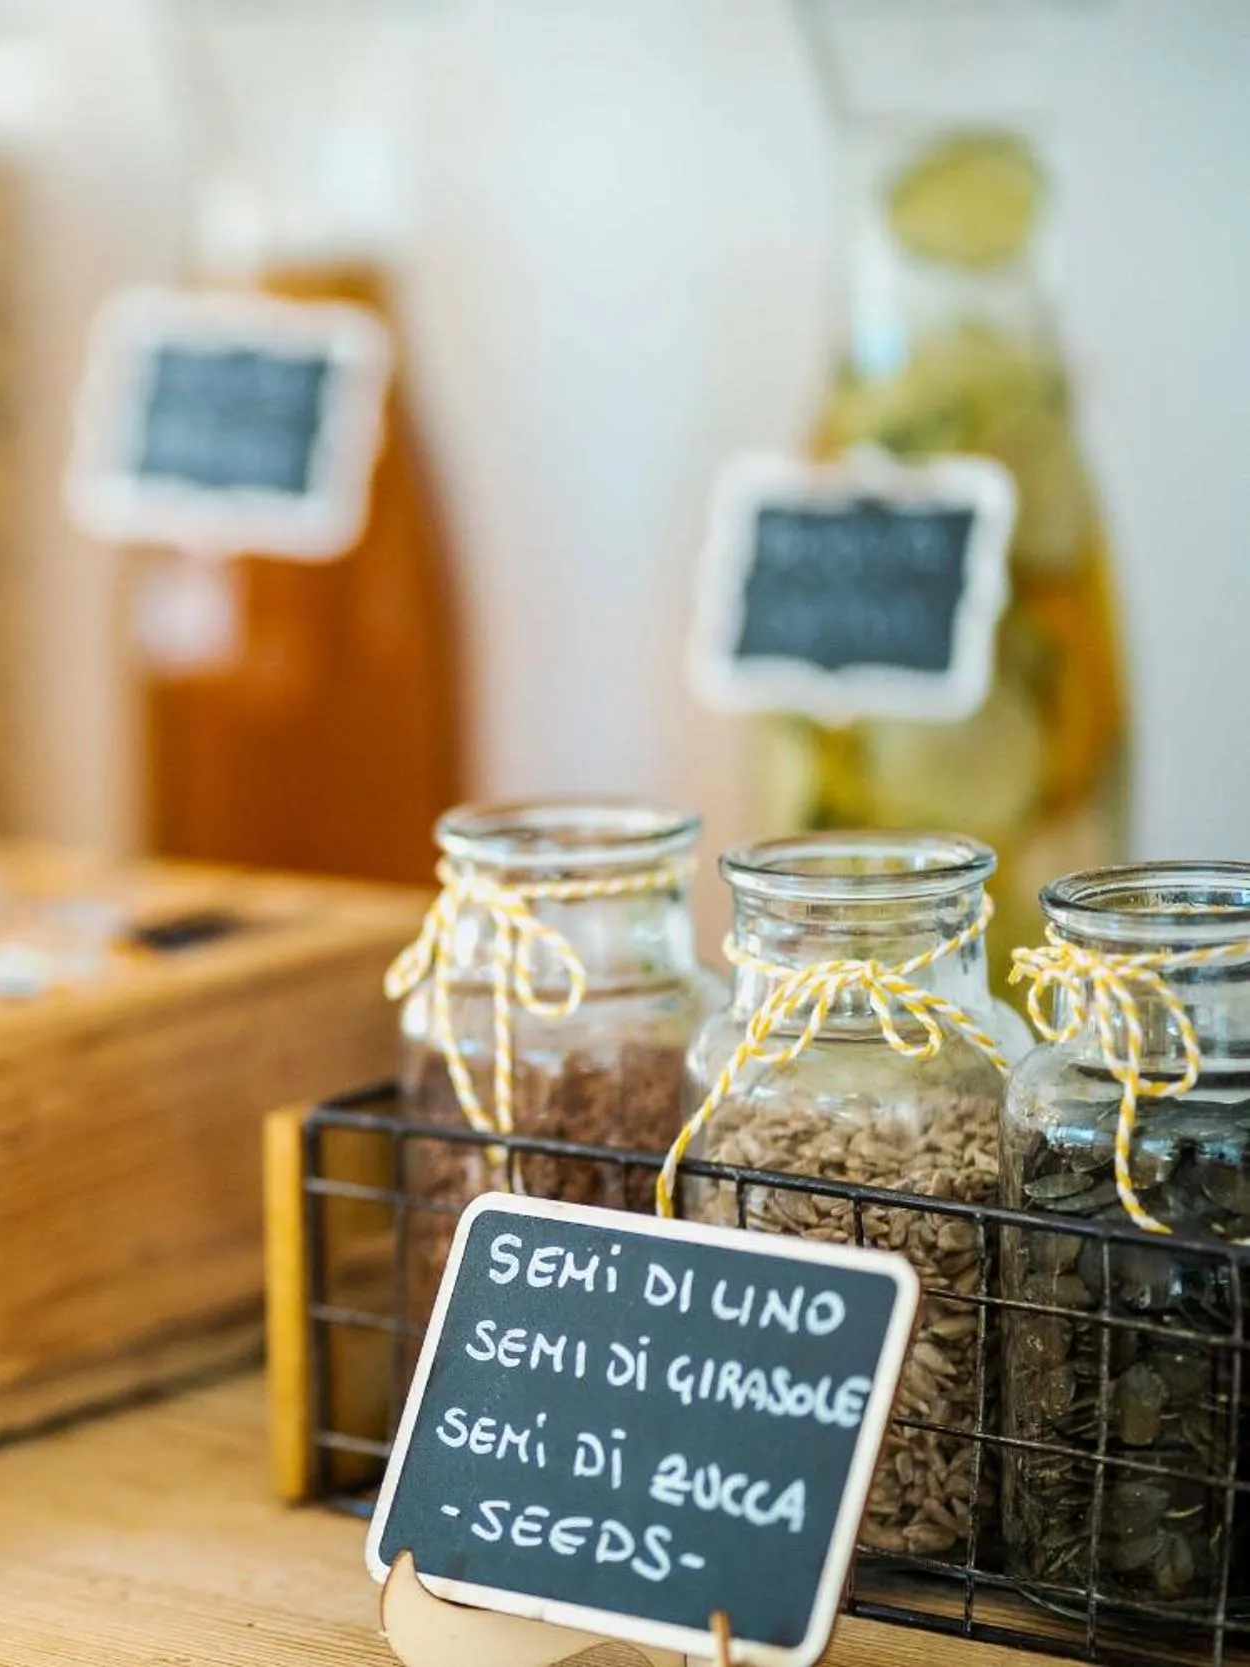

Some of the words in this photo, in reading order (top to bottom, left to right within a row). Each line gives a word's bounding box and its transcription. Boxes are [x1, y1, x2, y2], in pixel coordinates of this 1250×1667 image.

[643, 1262, 695, 1314] DI
[464, 1319, 588, 1379] SEMI
[666, 1354, 871, 1428] GIRASOLE
